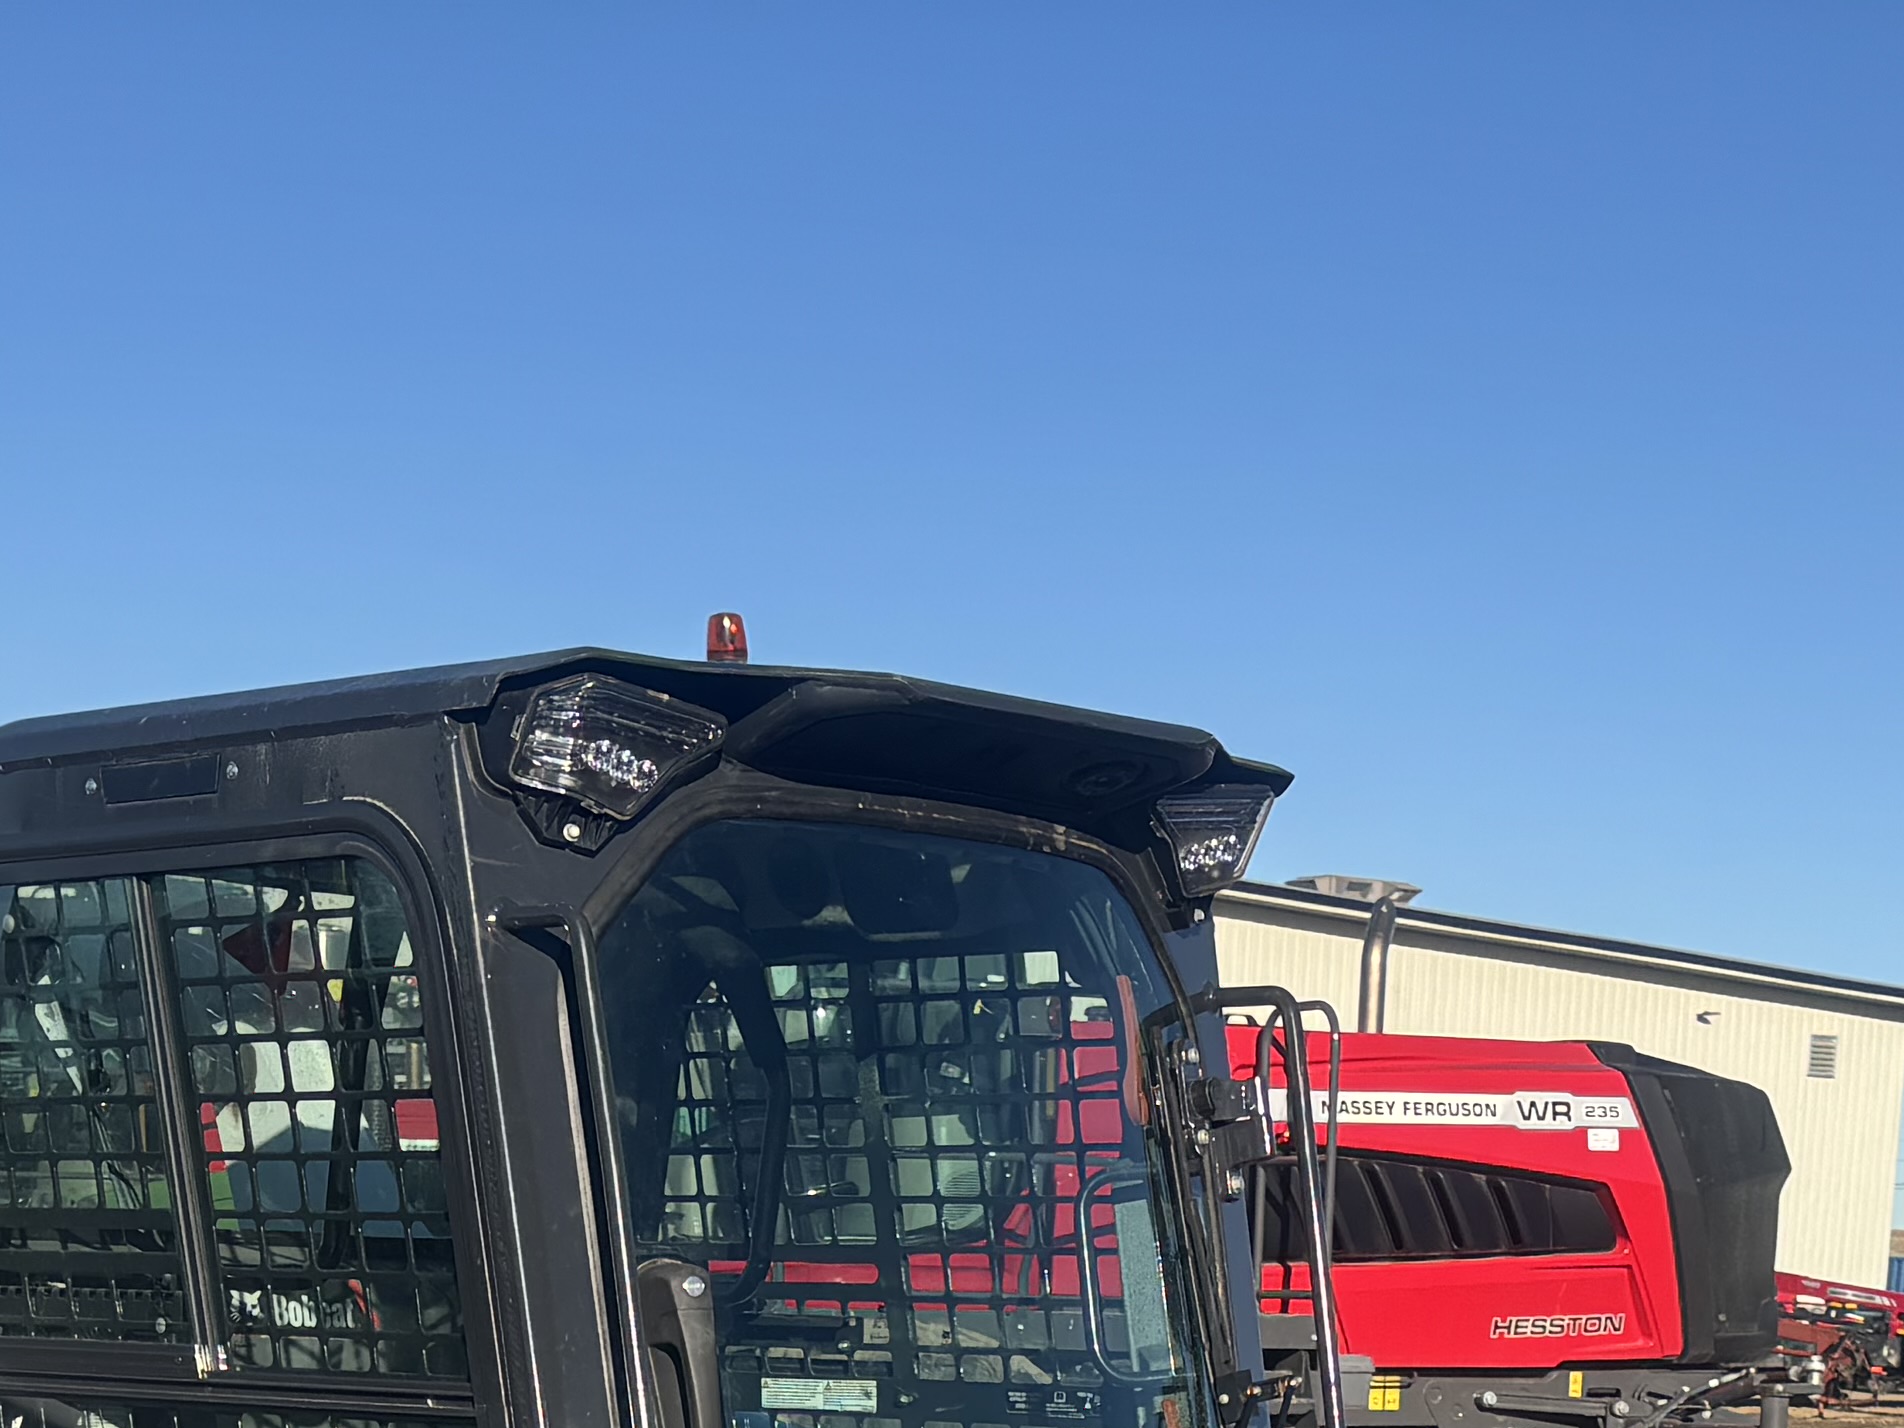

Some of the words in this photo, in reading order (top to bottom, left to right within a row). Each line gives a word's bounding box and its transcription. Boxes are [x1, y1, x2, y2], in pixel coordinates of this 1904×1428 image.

[1403, 1101, 1497, 1118] FERGUSON
[1516, 1100, 1573, 1123] WR
[1584, 1105, 1621, 1119] 235
[1490, 1313, 1626, 1339] HESSTON
